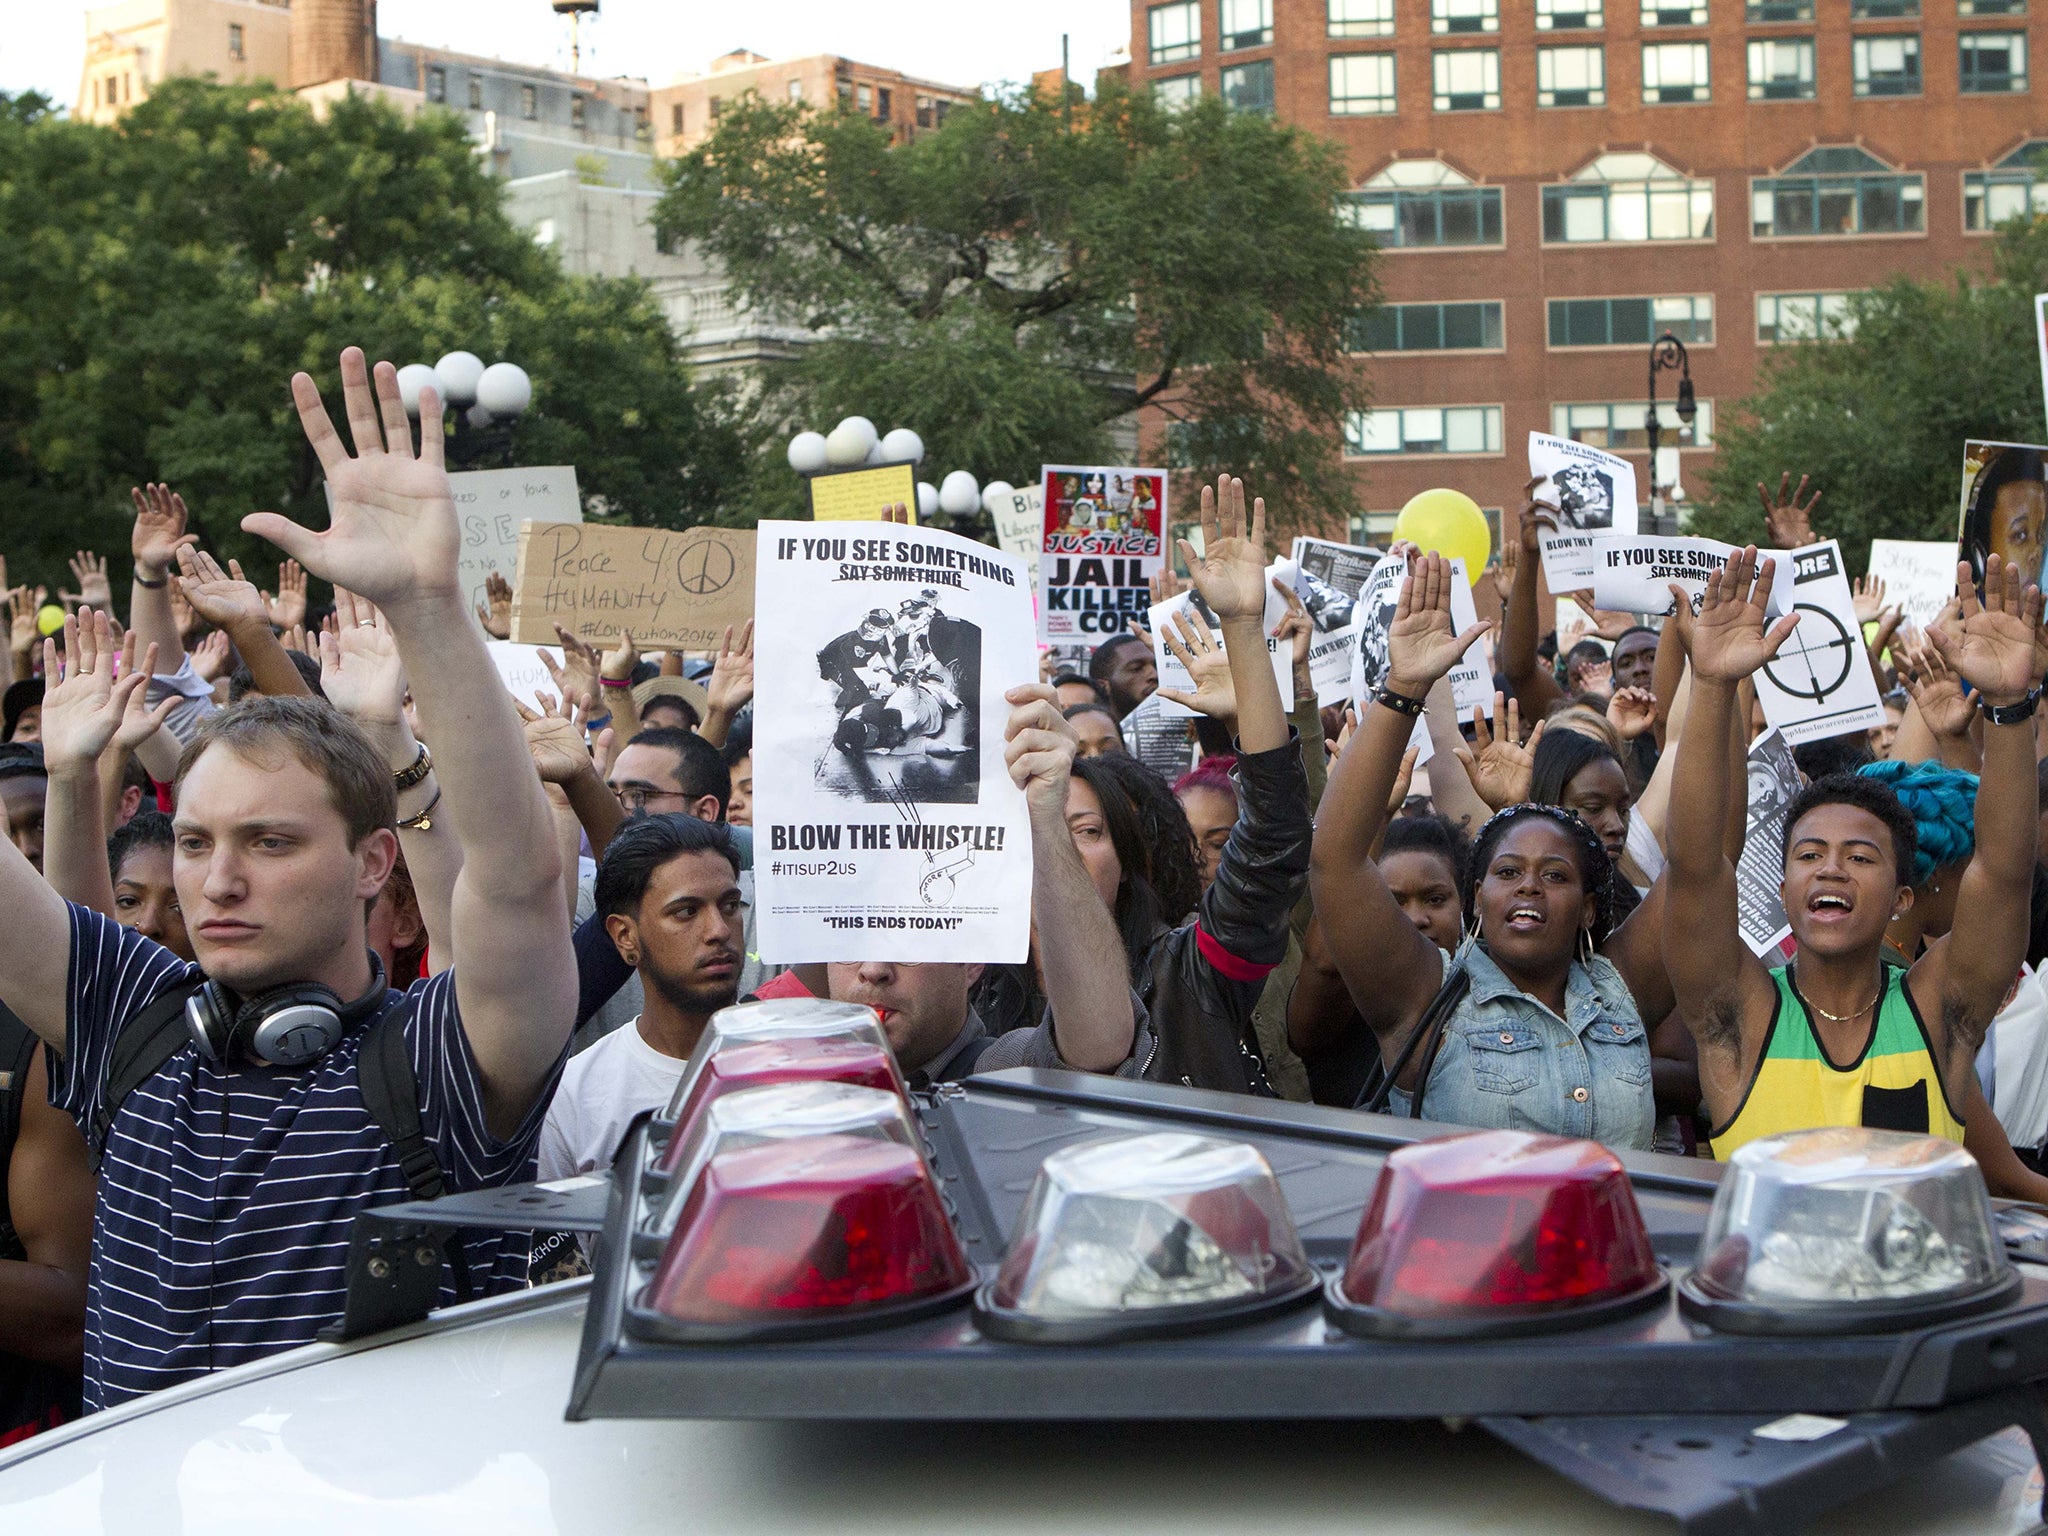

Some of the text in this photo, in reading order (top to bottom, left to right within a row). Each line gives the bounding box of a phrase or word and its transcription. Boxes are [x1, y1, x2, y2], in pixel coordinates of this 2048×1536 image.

[1547, 440, 1563, 449] YOU
[1012, 494, 1041, 513] Bla
[1046, 534, 1158, 554] JUSTICE
[1310, 543, 1339, 559] Three
[1546, 538, 1572, 550] BLOW
[1573, 537, 1587, 547] THE
[542, 523, 669, 585] Peace 4
[778, 538, 797, 560] IF
[803, 538, 846, 561] YOU
[853, 540, 890, 561] SEE
[895, 542, 1016, 587] SOMETHING
[1607, 550, 1620, 567] IF
[1623, 548, 1654, 566] YOU
[1658, 549, 1685, 565] SEE
[839, 564, 962, 588] SAY SOMETHING
[1048, 558, 1150, 587] JAIL
[1651, 566, 1672, 579] SAY
[1048, 588, 1151, 611] KILLER
[1333, 632, 1358, 651] WHISTL
[1783, 710, 1880, 738] opMassIncarceration.net
[771, 824, 1006, 851] BLOW THE WHISTLE!
[772, 860, 857, 876] #ITISUP2US
[867, 916, 906, 929] ENDS
[531, 1231, 571, 1265] SCHON
